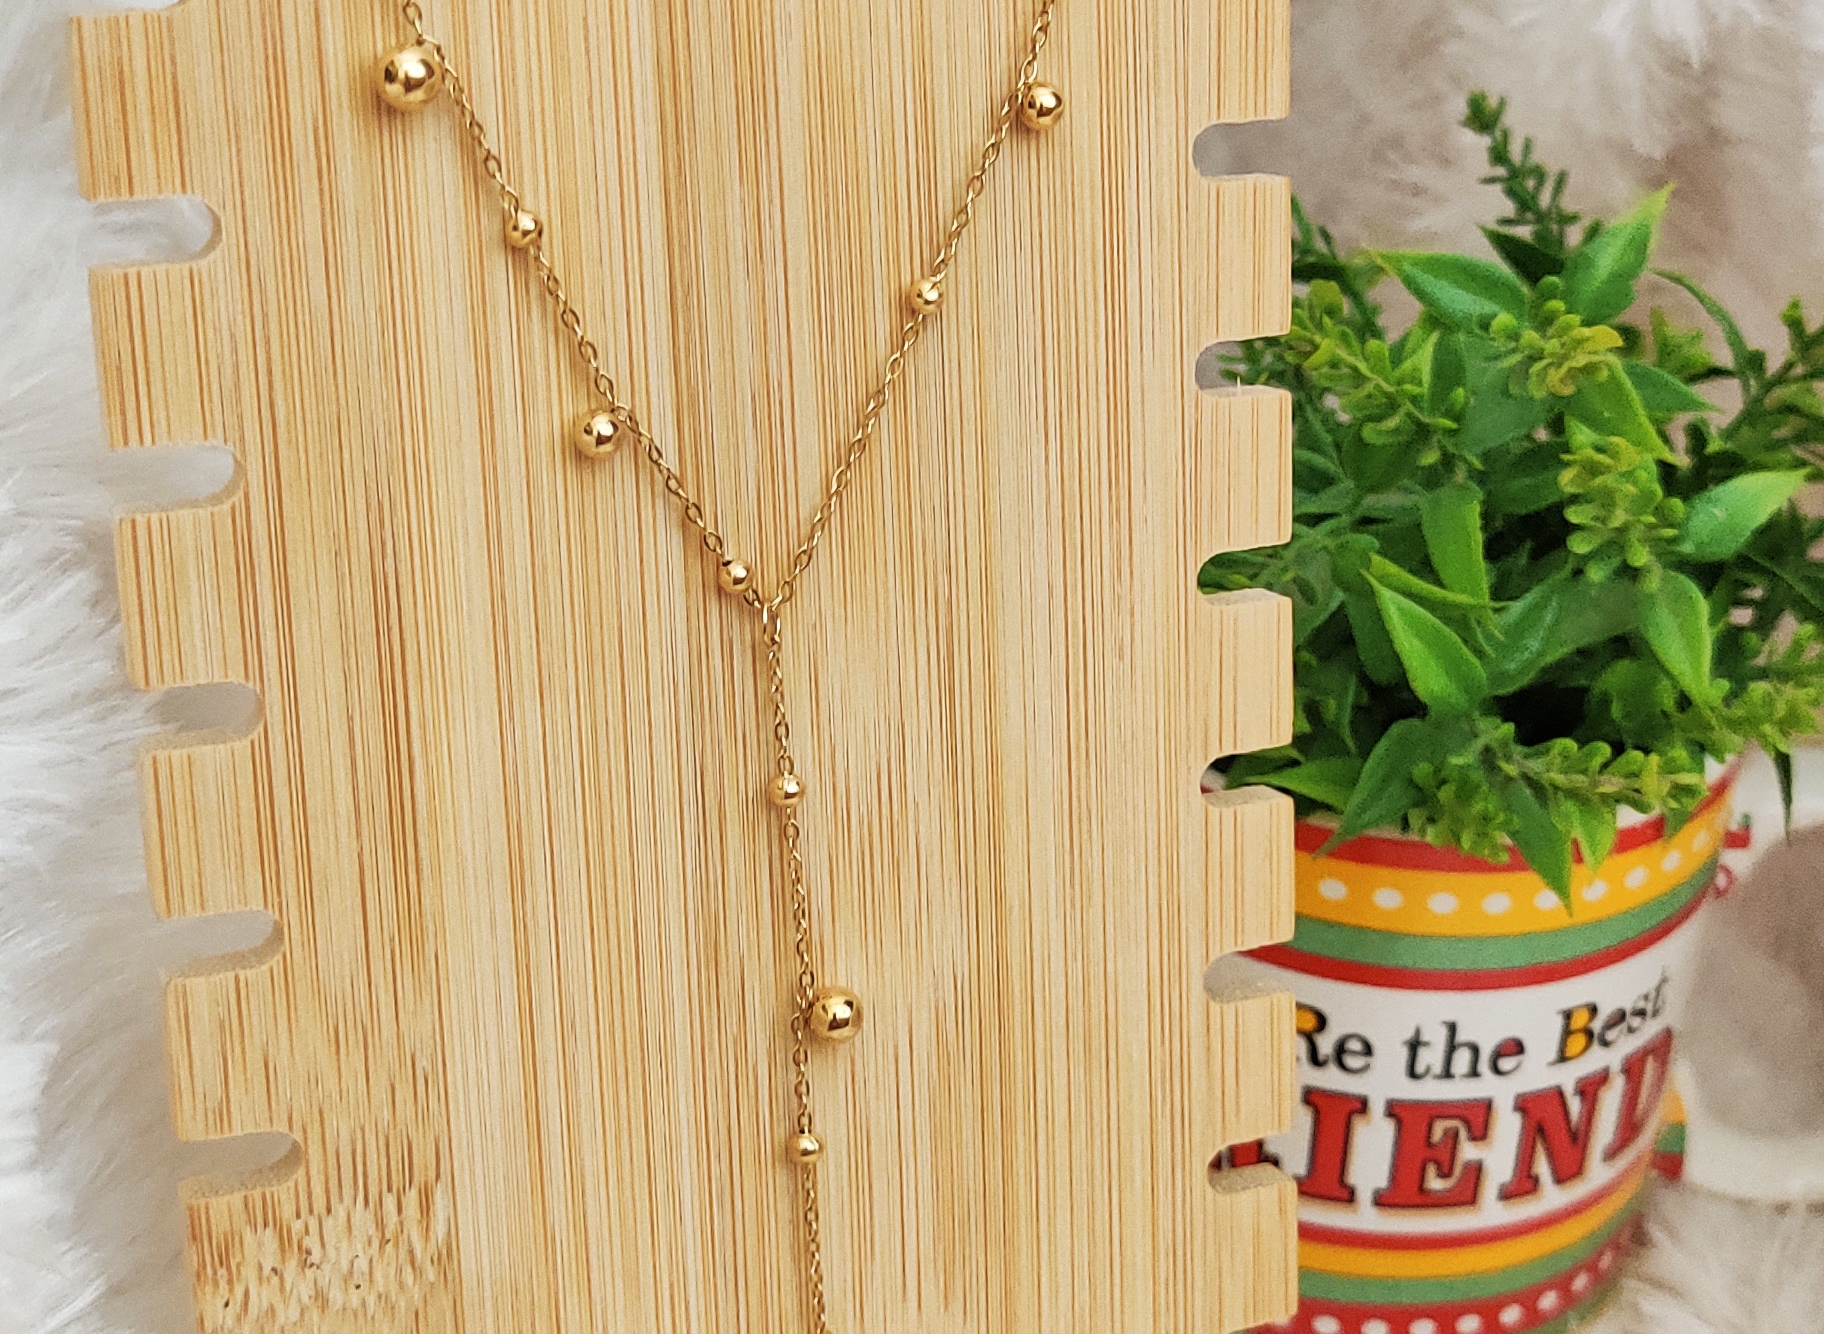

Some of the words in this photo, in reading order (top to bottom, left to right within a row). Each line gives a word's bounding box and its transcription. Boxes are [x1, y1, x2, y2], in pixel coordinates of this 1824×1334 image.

[1403, 1021, 1525, 1080] the
[1548, 967, 1669, 1066] Best
[1230, 1027, 1674, 1209] IEND
